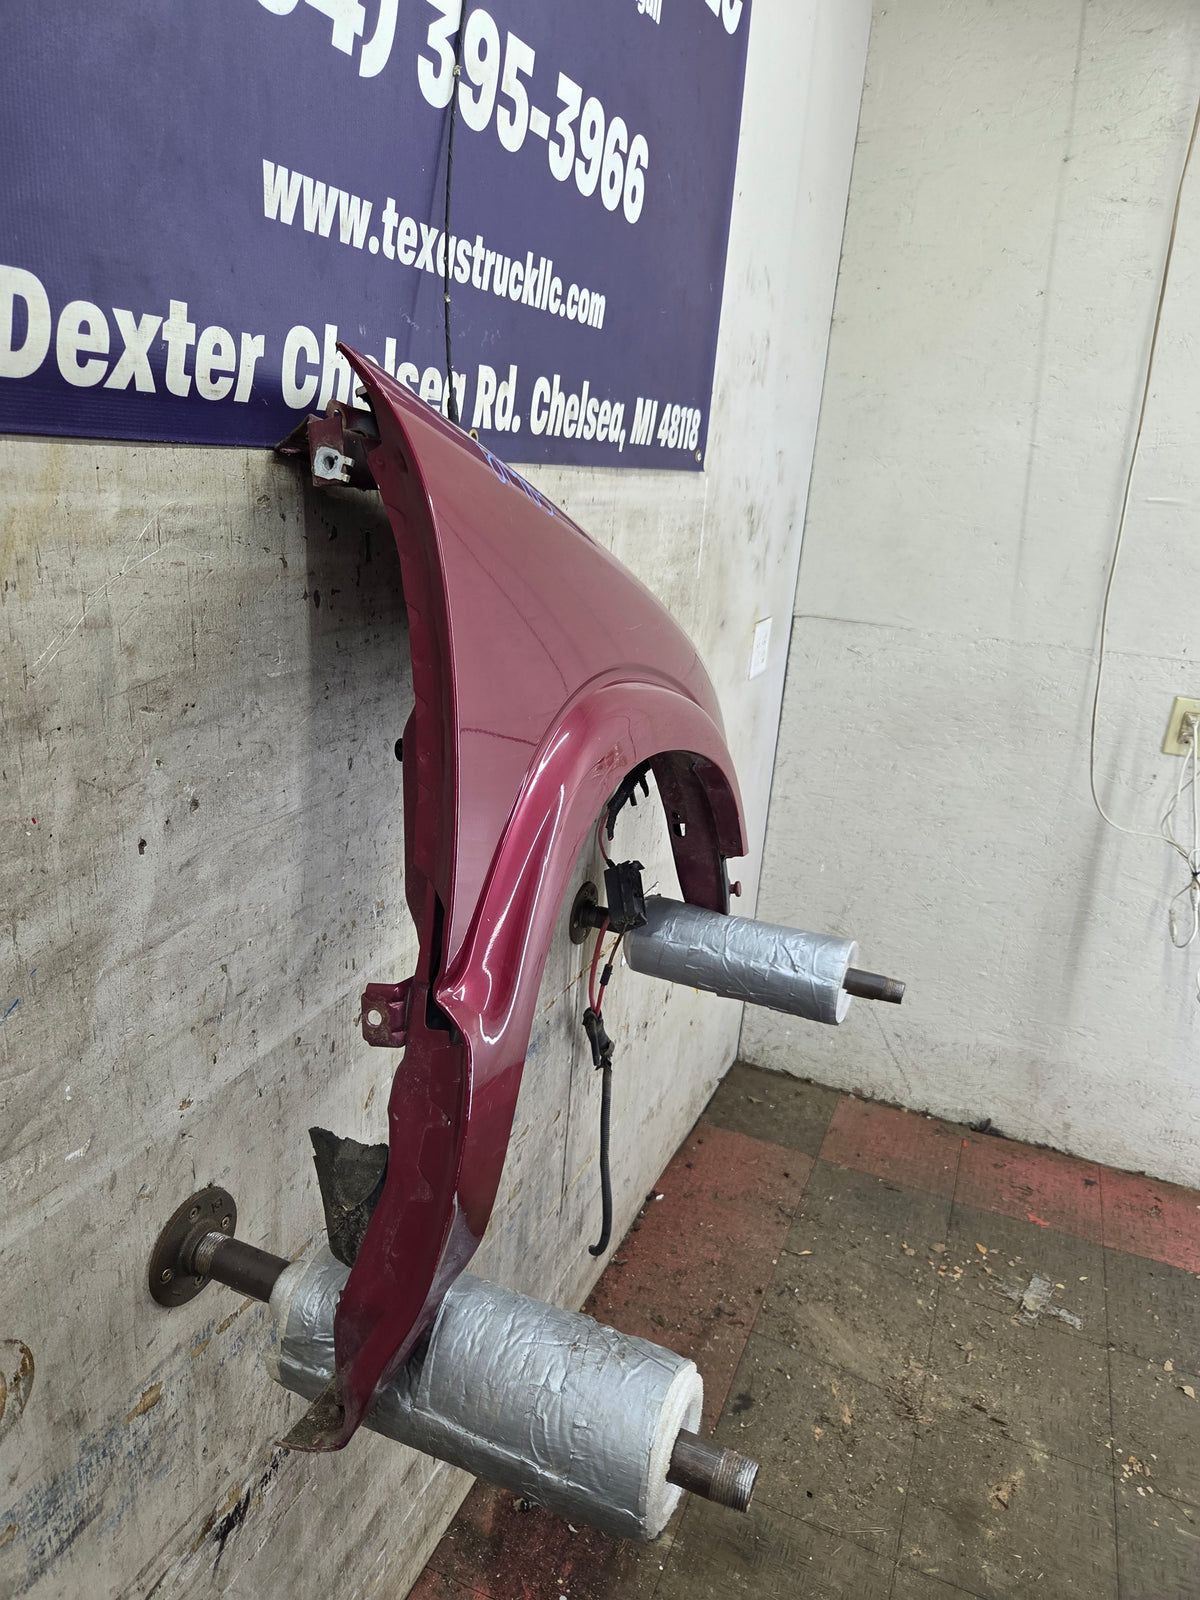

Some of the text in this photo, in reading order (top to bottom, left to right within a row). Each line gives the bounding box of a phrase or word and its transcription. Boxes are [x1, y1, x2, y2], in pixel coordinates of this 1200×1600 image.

[418, 0, 648, 224] 395-3966
[263, 159, 606, 329] www.texastruckllc.com
[0, 264, 265, 402] Dexter
[471, 364, 521, 433] Rd.
[530, 374, 626, 452] Chelsea,
[629, 397, 658, 446] MI
[657, 403, 701, 451] 48118
